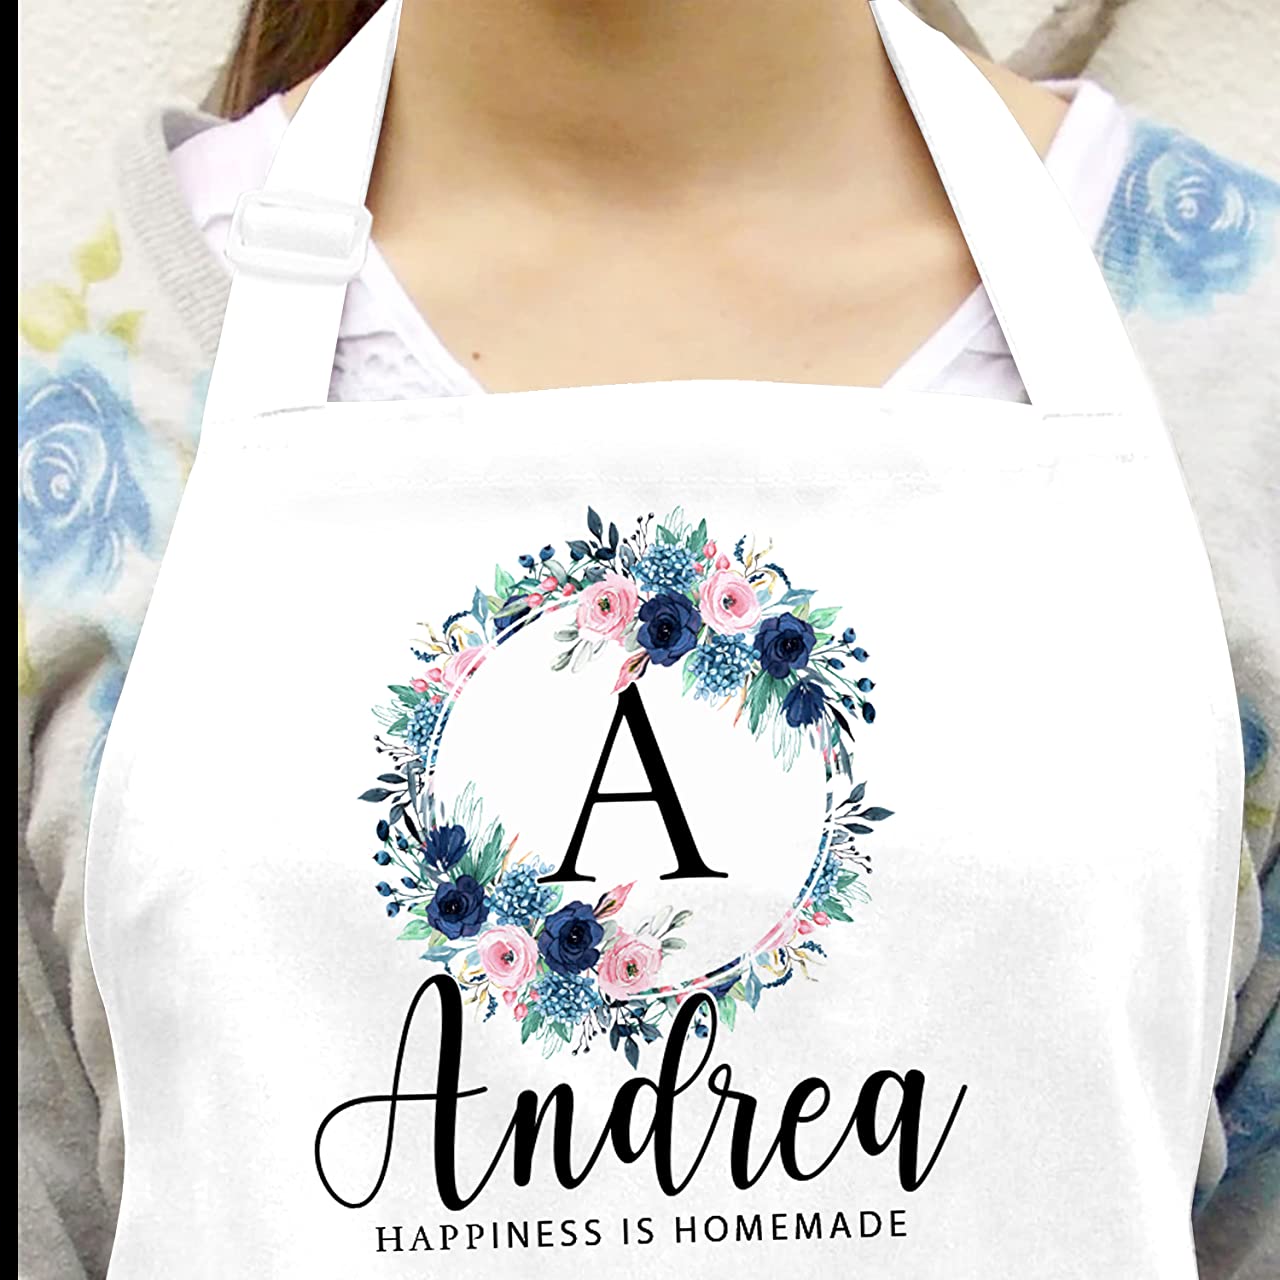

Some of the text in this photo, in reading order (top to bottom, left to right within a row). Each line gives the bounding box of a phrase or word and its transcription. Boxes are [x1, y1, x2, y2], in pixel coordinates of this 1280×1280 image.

[536, 682, 729, 884] A
[314, 973, 967, 1211] Andrea
[375, 1209, 907, 1253] HAPPINESS IS HOMEMADE
